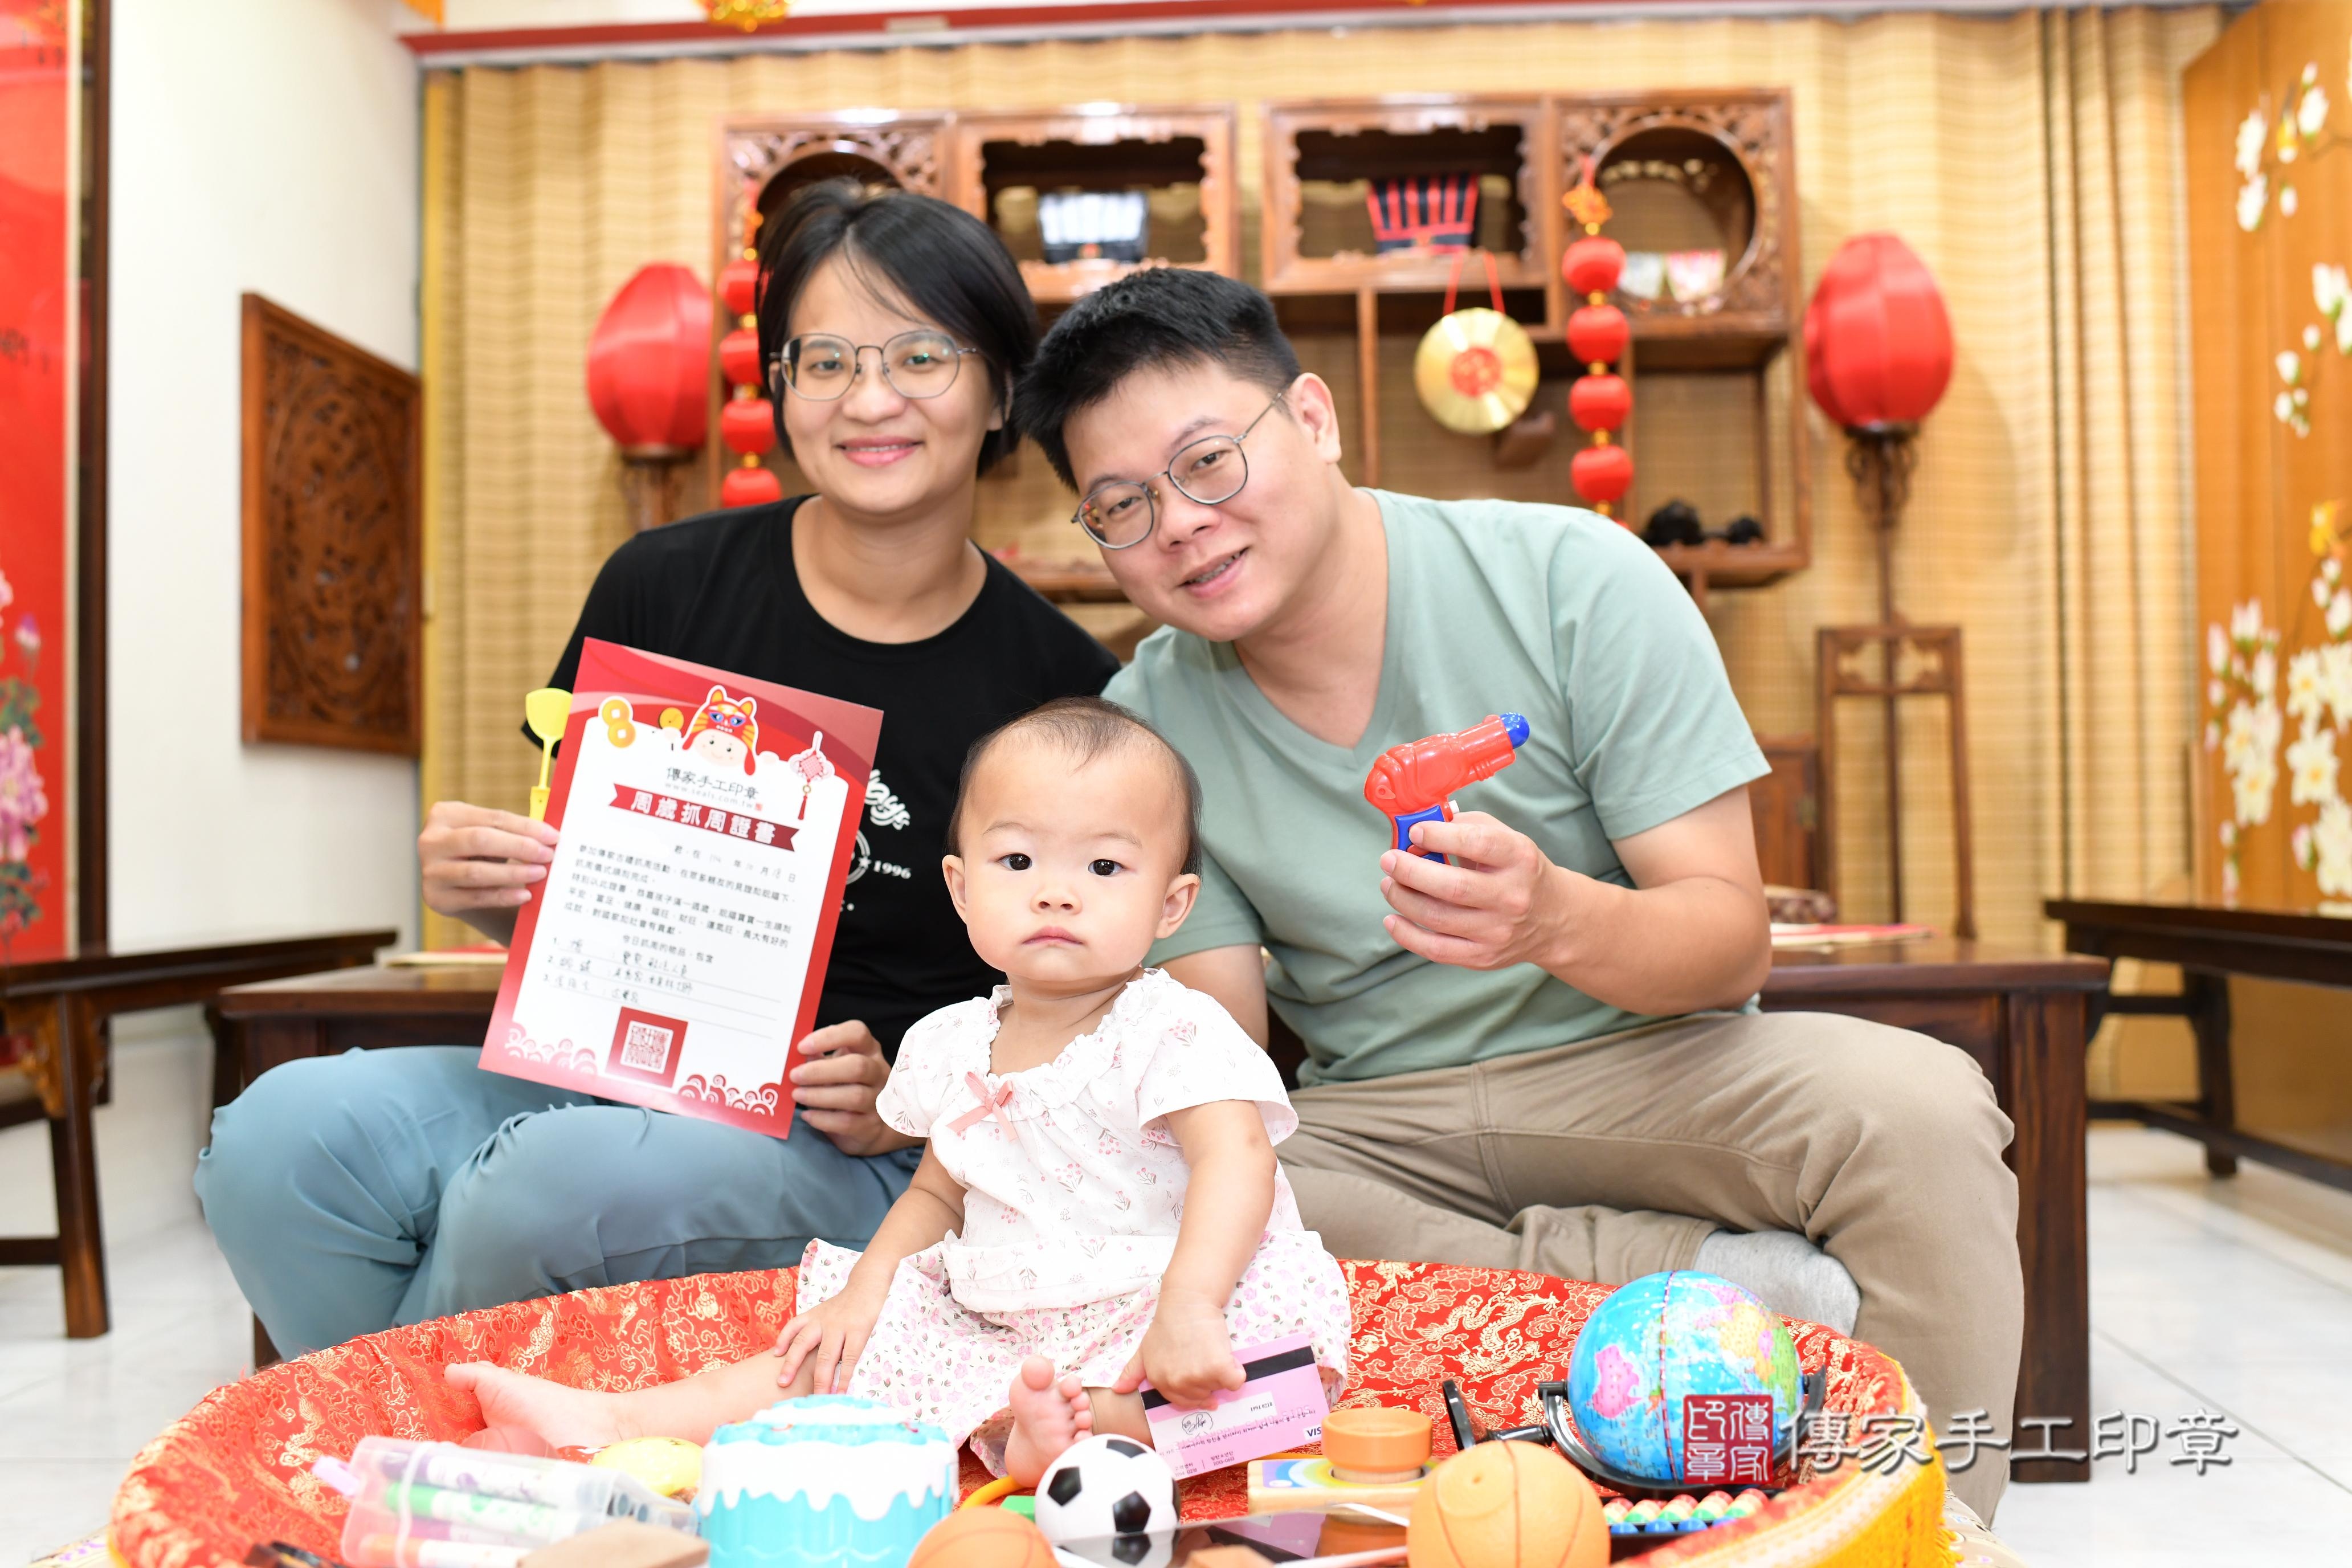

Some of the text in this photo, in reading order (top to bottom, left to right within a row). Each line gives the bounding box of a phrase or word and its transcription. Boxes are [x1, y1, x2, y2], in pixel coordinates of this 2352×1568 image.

[666, 766, 758, 800] 傳家手工印章
[631, 790, 777, 844] 周歲抓周證書
[873, 860, 911, 879] 1996
